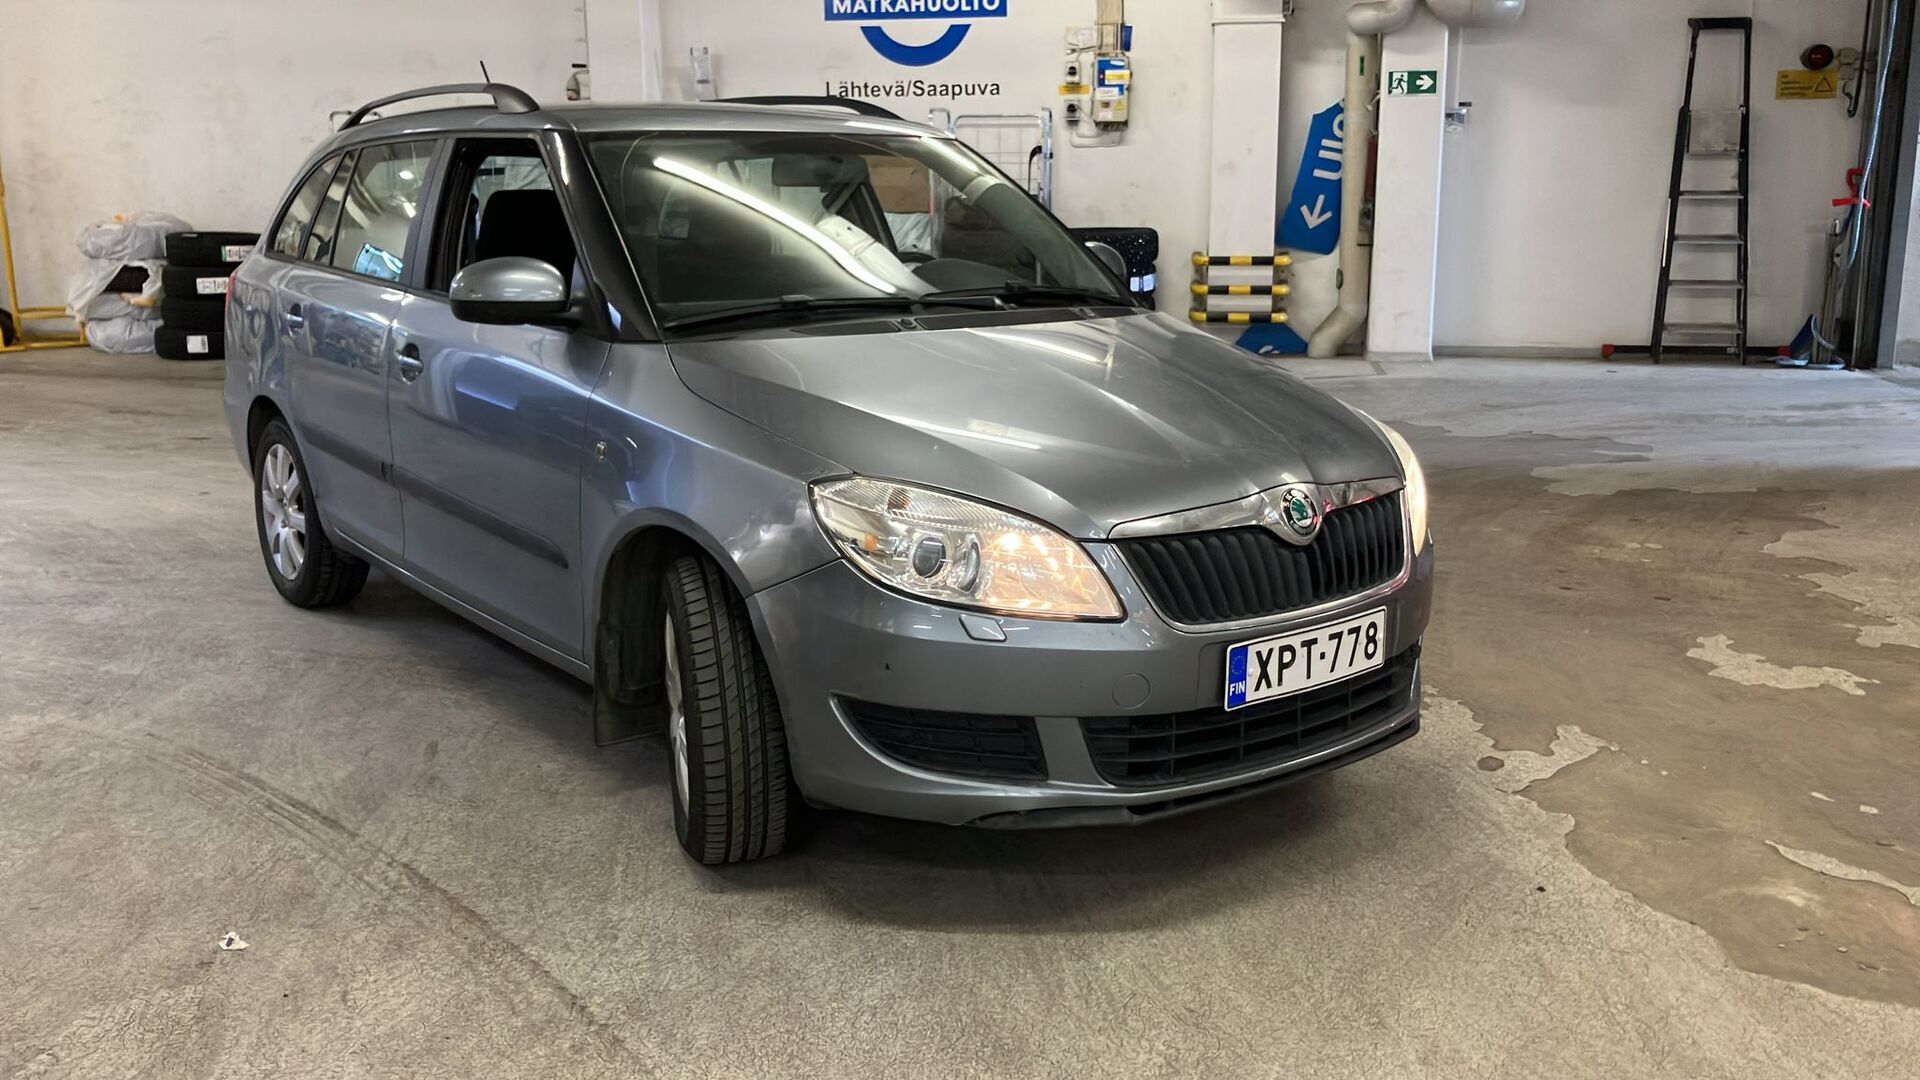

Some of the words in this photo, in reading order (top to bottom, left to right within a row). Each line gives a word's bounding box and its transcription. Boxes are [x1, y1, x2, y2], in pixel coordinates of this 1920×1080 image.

[833, 0, 1000, 14] MATKAHUOLTO
[826, 79, 1001, 100] Lähtevä/Saapuva
[1253, 621, 1379, 692] XPT-778
[1229, 680, 1246, 697] FIN
